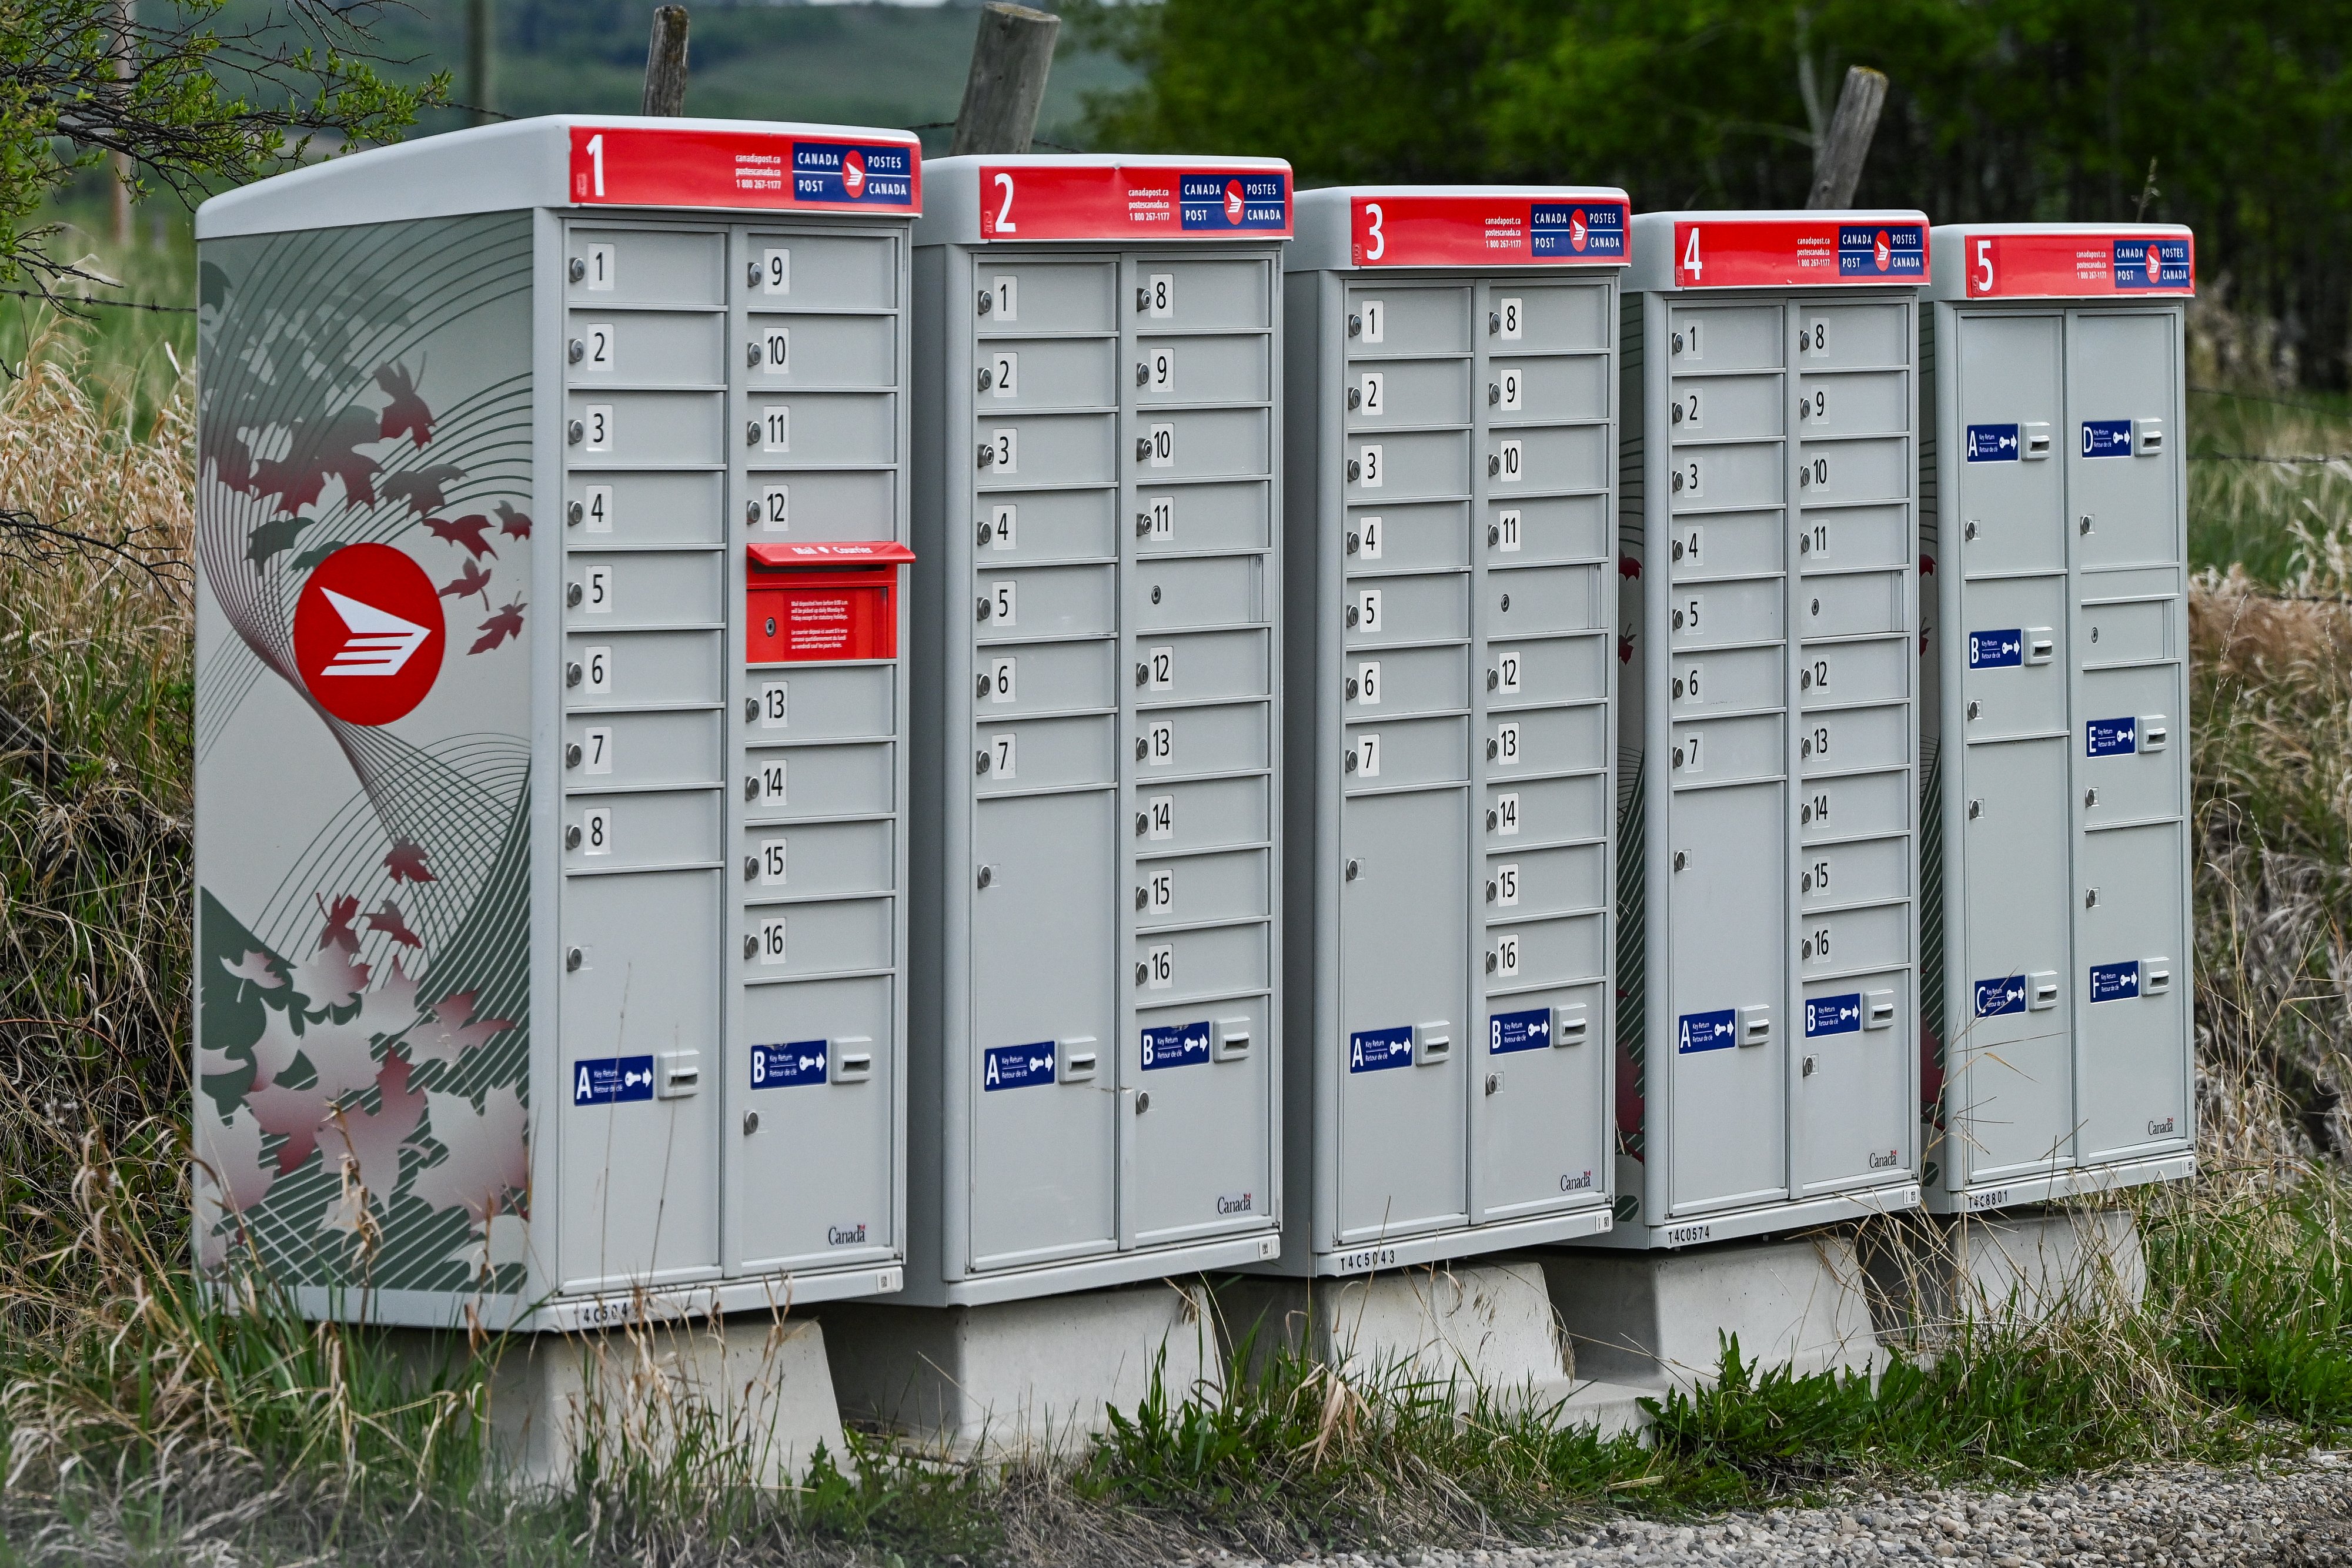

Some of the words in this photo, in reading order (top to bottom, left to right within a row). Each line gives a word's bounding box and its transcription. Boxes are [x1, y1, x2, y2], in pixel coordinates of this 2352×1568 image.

[586, 134, 605, 197] 1
[736, 153, 781, 164] canadapost.ca
[798, 152, 839, 166] CANADA
[868, 156, 901, 168] POSTES
[799, 180, 823, 192] POST
[868, 183, 907, 195] CANADA
[1128, 188, 1169, 198] canadapost.ca
[1185, 184, 1221, 195] CANADA
[1247, 184, 1276, 195] POSTES
[994, 173, 1016, 232] 2
[1128, 200, 1169, 210] postescanada.ca
[1185, 210, 1207, 221] POST
[1247, 209, 1281, 220] CANADA
[1129, 212, 1133, 220] 1
[1134, 212, 1144, 220] 800
[1145, 212, 1170, 221] 267-1177
[1485, 216, 1521, 226] canadapost.ca
[1535, 213, 1567, 224] CANADA
[1590, 213, 1616, 223] POSTES
[1365, 203, 1385, 260] 3
[1485, 228, 1521, 238] postescanada.ca
[1535, 238, 1555, 248] POST
[1591, 237, 1619, 248] CANADA
[1797, 237, 1830, 246] canadapost.ca
[1842, 234, 1872, 245] CANADA
[1892, 234, 1916, 245] POSTES
[1683, 228, 1702, 280] 4
[1797, 248, 1830, 257] postescanada.ca
[1810, 259, 1830, 267] 267-1177
[1843, 258, 1860, 268] POST
[1893, 258, 1920, 268] CANADA
[1977, 240, 1993, 292] 5
[2076, 250, 2106, 259] canadapost.ca
[2076, 261, 2106, 270] postescanada.ca
[2117, 248, 2143, 258] CANADA
[2161, 248, 2183, 258] POSTES
[596, 252, 603, 281] 1
[771, 256, 783, 286] 9
[2117, 270, 2134, 280] POST
[2162, 270, 2187, 280] CANADA
[1000, 283, 1007, 312] 1
[1156, 281, 1166, 309] 8
[1369, 308, 1375, 335] 1
[1506, 305, 1516, 332] 8
[594, 332, 605, 362] 2
[1690, 326, 1695, 352] 1
[1816, 324, 1825, 349] 8
[767, 336, 786, 365] 10
[999, 360, 1009, 389] 2
[1157, 356, 1167, 384] 9
[1368, 380, 1377, 407] 2
[1506, 376, 1515, 403] 9
[1689, 395, 1698, 421] 2
[1816, 391, 1825, 417] 9
[593, 413, 604, 443] 3
[768, 414, 784, 443] 11
[2083, 427, 2093, 453] D
[999, 436, 1008, 464] 3
[1154, 430, 1170, 459] 10
[1968, 430, 1978, 457] A
[1367, 452, 1376, 479] 3
[1504, 447, 1518, 474] 10
[1813, 459, 1827, 484] 10
[1689, 463, 1698, 490] 3
[591, 493, 603, 523] 4
[767, 493, 784, 522] 12
[1154, 504, 1168, 532] 11
[997, 513, 1008, 540] 4
[1365, 524, 1375, 551] 4
[1503, 517, 1516, 544] 11
[1814, 526, 1826, 551] 11
[1688, 533, 1698, 559] 4
[593, 574, 603, 604] 5
[999, 589, 1008, 617] 5
[1366, 597, 1375, 624] 5
[1690, 601, 1698, 627] 5
[1971, 637, 1979, 663] B
[592, 654, 603, 684] 6
[998, 665, 1008, 694] 6
[1153, 654, 1169, 682] 12
[1502, 659, 1516, 686] 12
[1814, 661, 1828, 687] 12
[1365, 669, 1374, 696] 6
[1689, 670, 1698, 696] 6
[766, 689, 784, 719] 13
[592, 735, 603, 764] 7
[1152, 728, 1170, 757] 13
[1501, 730, 1516, 757] 13
[1689, 738, 1698, 764] 7
[1814, 728, 1828, 754] 13
[2089, 727, 2096, 753] E
[998, 741, 1008, 770] 7
[1364, 742, 1373, 768] 7
[764, 768, 783, 797] 14
[1152, 803, 1171, 831] 14
[1500, 800, 1516, 827] 14
[1813, 795, 1828, 821] 14
[591, 817, 603, 847] 8
[765, 846, 783, 875] 15
[1500, 871, 1515, 898] 15
[1814, 862, 1828, 888] 15
[1152, 877, 1170, 905] 15
[764, 925, 783, 955] 16
[1815, 930, 1829, 956] 16
[1152, 951, 1170, 980] 16
[1500, 942, 1516, 969] 16
[2093, 972, 2099, 998] F
[1977, 987, 1986, 1013] C
[1808, 1005, 1815, 1032] B
[1492, 1020, 1501, 1049] B
[1680, 1020, 1691, 1048] A
[1144, 1034, 1153, 1065] B
[1352, 1038, 1364, 1067] A
[753, 1051, 765, 1083] B
[986, 1054, 1000, 1085] A
[576, 1065, 592, 1099] A
[2148, 1118, 2173, 1135] Canada
[1869, 1151, 1896, 1168] Canada
[1561, 1171, 1591, 1191] Canada
[1217, 1193, 1251, 1215] Canada
[1969, 1190, 2007, 1209] T4C8801
[828, 1224, 865, 1245] Canada
[1668, 1226, 1709, 1243] T4C0574
[1341, 1250, 1395, 1271] T4C5043
